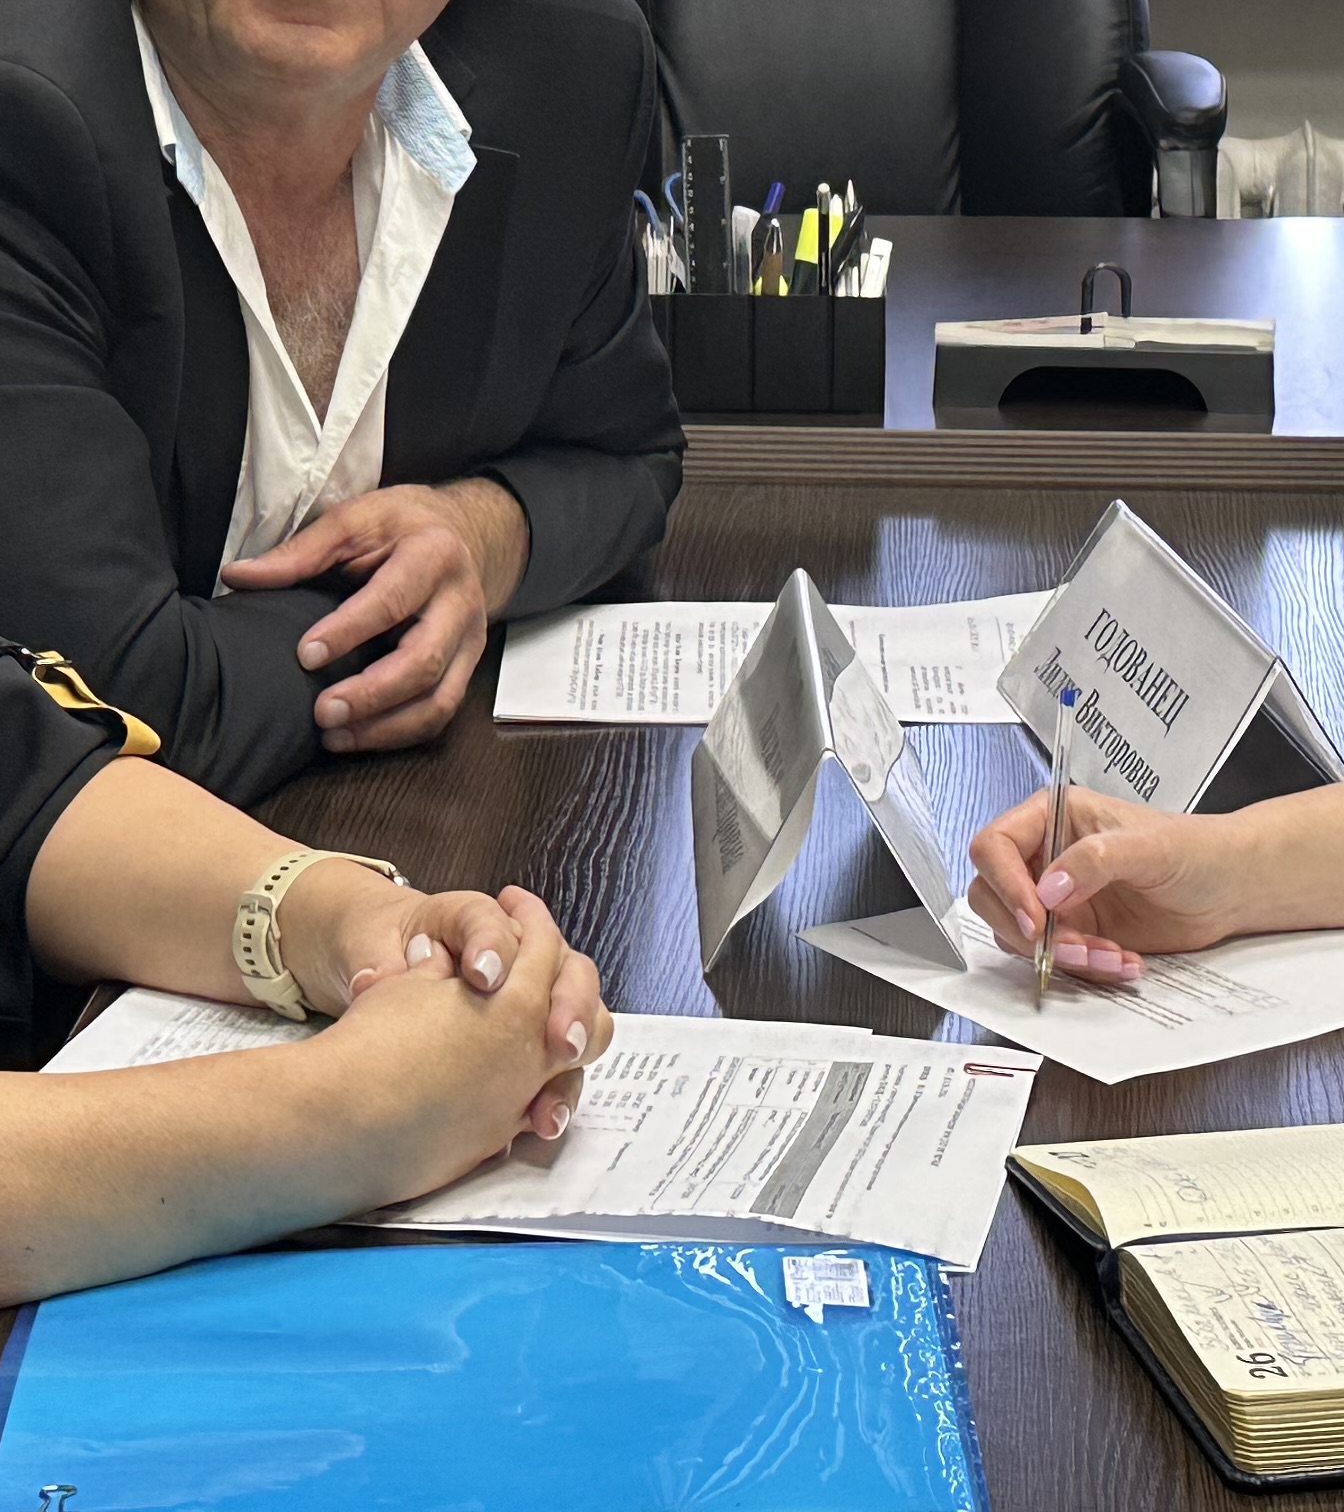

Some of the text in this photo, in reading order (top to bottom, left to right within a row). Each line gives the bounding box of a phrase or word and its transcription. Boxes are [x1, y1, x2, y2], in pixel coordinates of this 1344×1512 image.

[1084, 608, 1189, 738] ГОДОВАНЕЦ
[1075, 689, 1160, 803] Викторовна
[1236, 1353, 1289, 1379] 26
